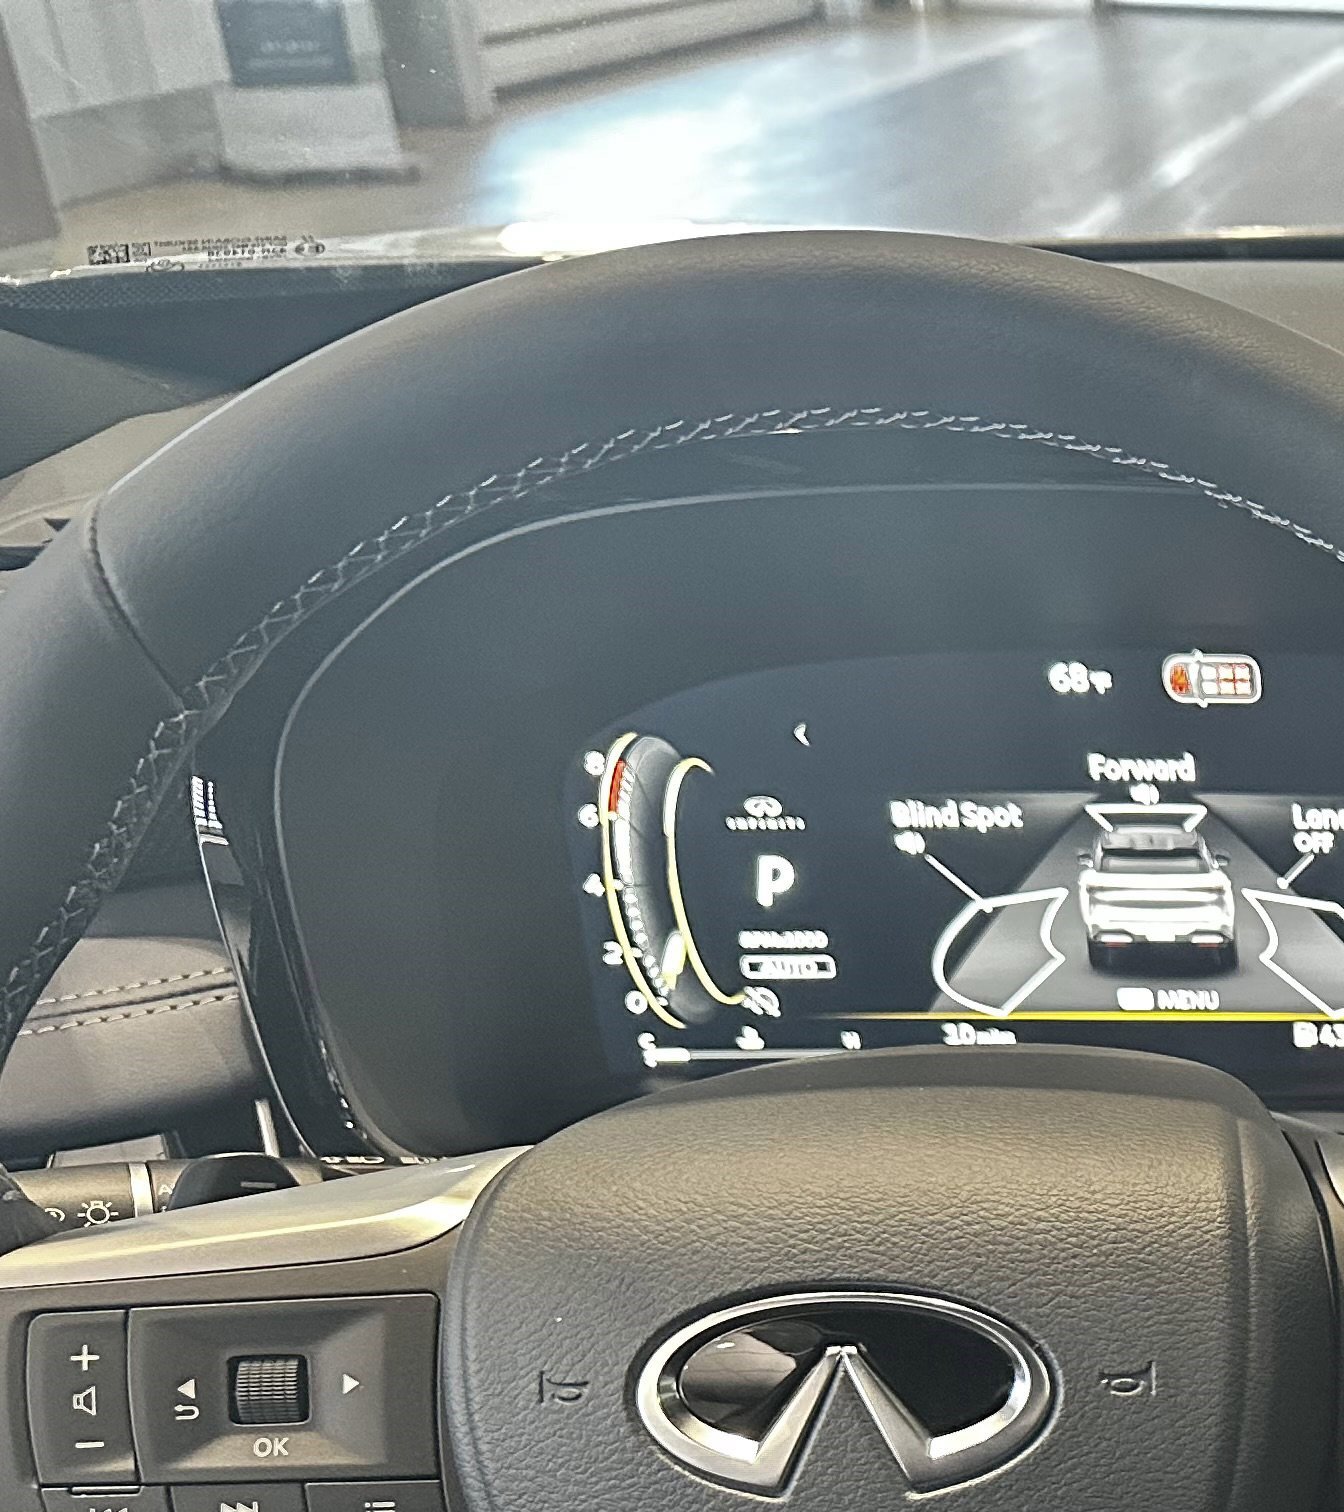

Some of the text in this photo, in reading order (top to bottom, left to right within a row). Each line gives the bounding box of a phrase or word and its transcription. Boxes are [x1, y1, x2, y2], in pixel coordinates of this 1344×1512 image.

[1087, 752, 1196, 781] Forward
[890, 799, 1023, 833] Blind Spot
[757, 855, 795, 906] P
[1157, 989, 1220, 1010] MENU
[253, 1438, 289, 1458] OK
